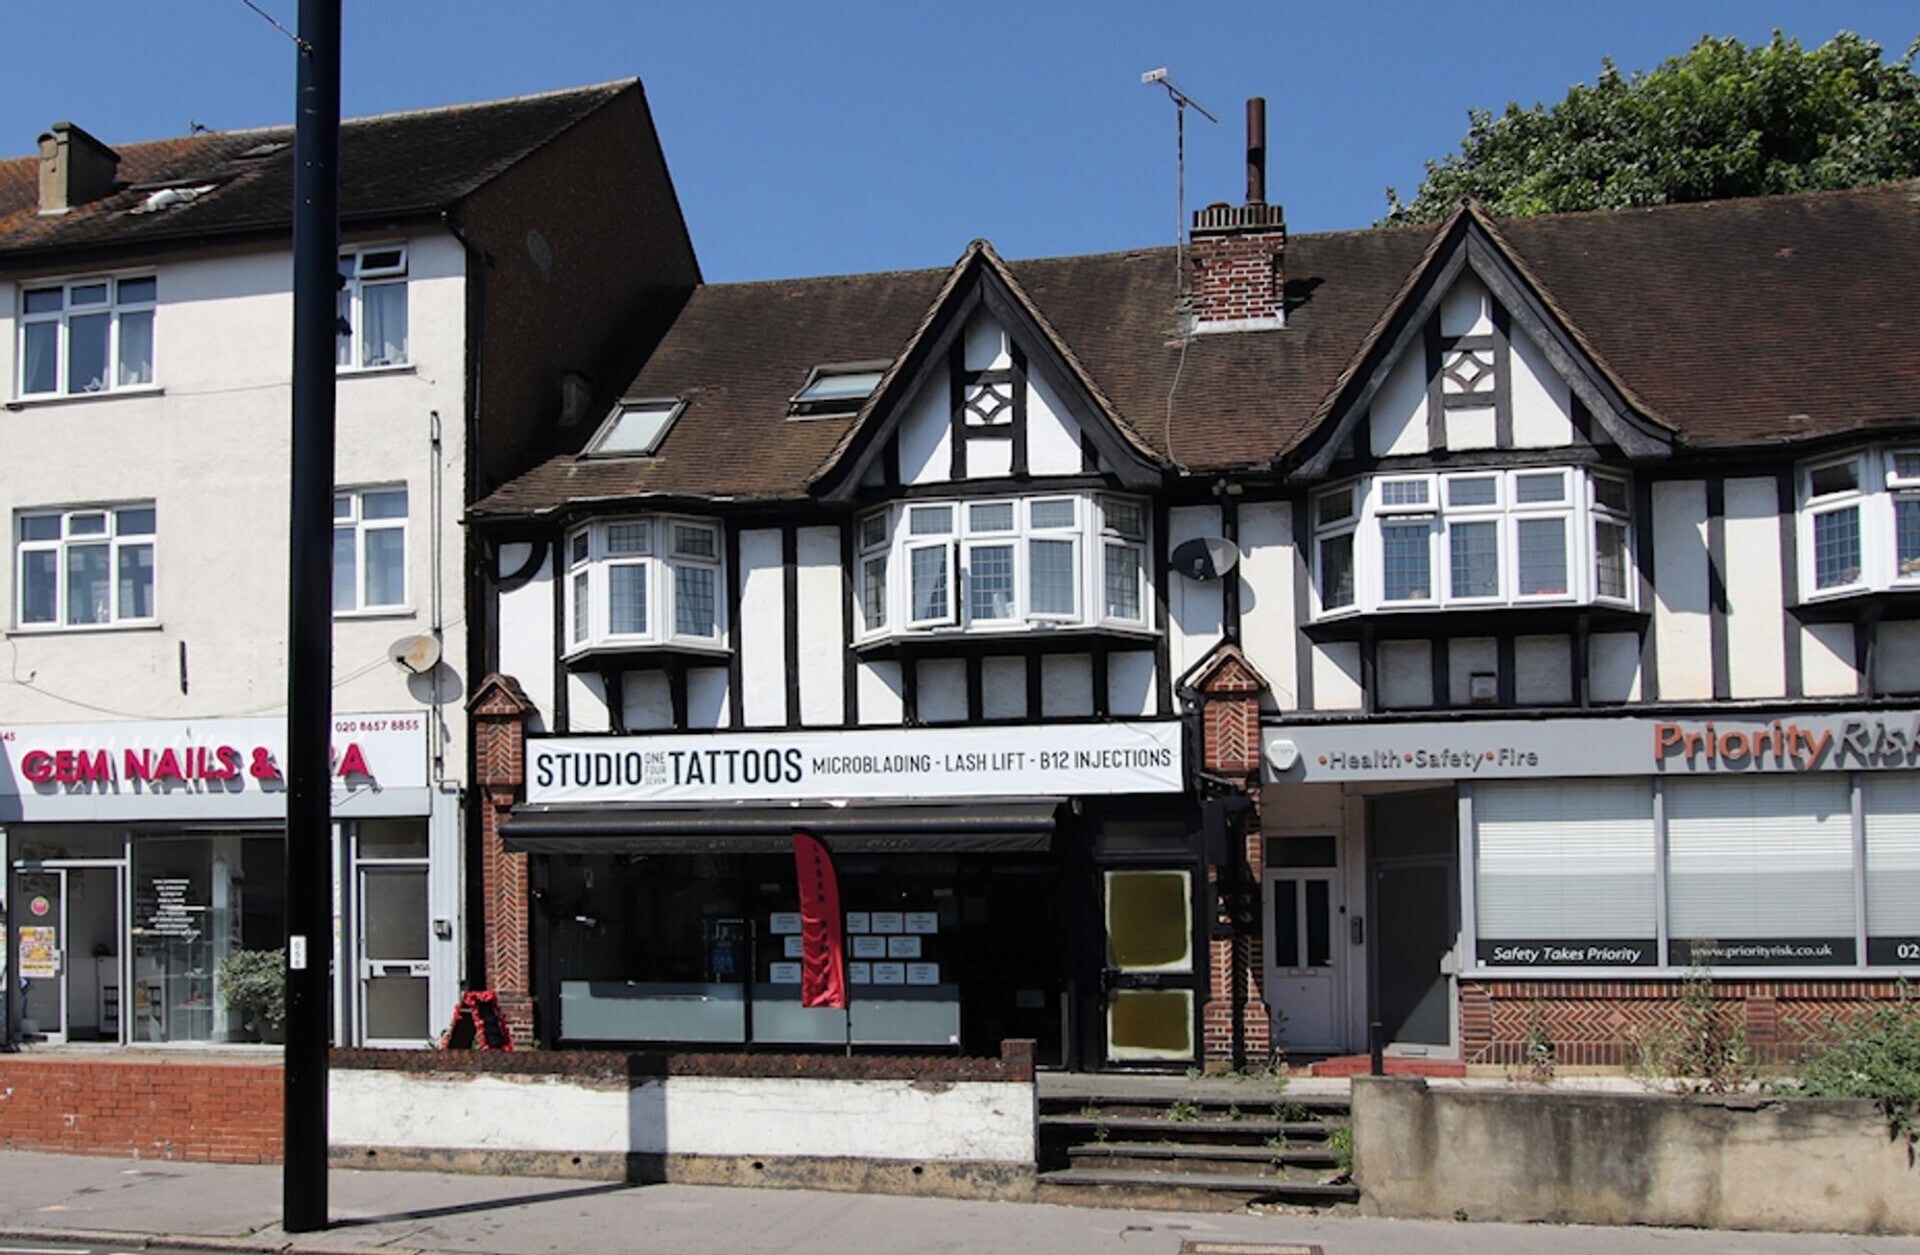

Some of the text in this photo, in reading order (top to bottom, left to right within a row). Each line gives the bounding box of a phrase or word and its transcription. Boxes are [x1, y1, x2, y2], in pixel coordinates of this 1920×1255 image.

[335, 720, 419, 732] 020 8657 8855
[1654, 719, 1833, 770] Priority
[22, 745, 279, 783] GEM NAILS &
[644, 751, 666, 764] ONE
[1329, 748, 1539, 772] Health Safety Fire
[536, 748, 1172, 787] STUDIO TATTOOS MICROBLADING LASH LIFT B12 INJECTIONS
[644, 764, 667, 775] FOUR
[644, 775, 667, 785] SEVEN
[1493, 946, 1642, 963] Safety Takes Priority
[1689, 943, 1833, 959] www.priorityrisk.co.uk
[1897, 943, 1920, 959] 02
